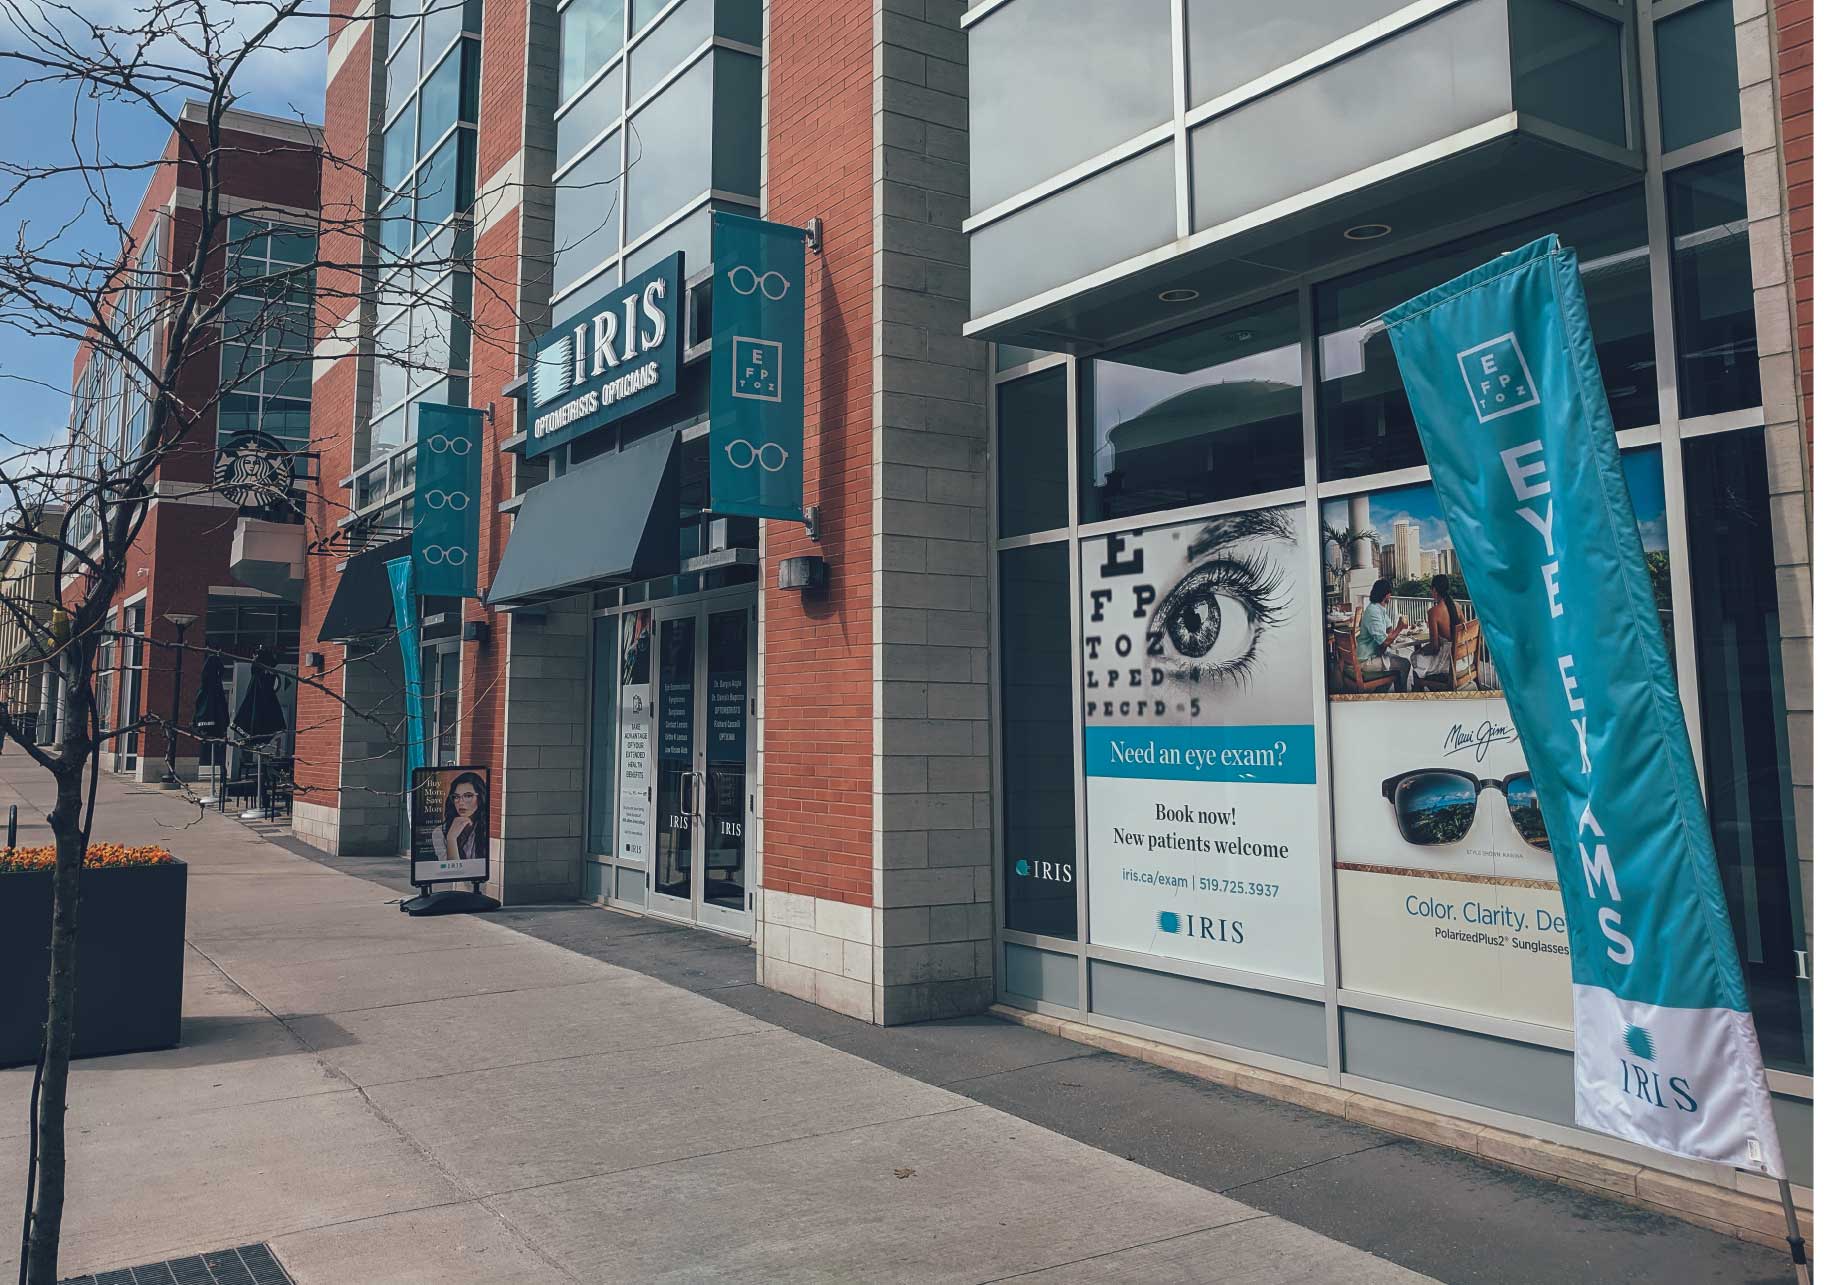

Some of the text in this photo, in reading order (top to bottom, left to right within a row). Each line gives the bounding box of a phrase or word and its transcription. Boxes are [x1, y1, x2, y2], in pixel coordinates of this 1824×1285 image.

[573, 277, 666, 386] IRIS
[752, 349, 763, 365] E
[1480, 353, 1498, 375] E
[534, 361, 660, 438] OPTOMETRISTS OPTICIANS
[1499, 440, 1564, 619] EYE
[1100, 530, 1144, 578] E
[1443, 724, 1475, 749] Maui
[625, 751, 646, 759] EXTENDED
[1110, 740, 1287, 770] Need an eye exam?
[626, 771, 644, 779] BENEFITS
[669, 815, 689, 830] IRIS
[1155, 803, 1236, 826] Book now!
[721, 821, 742, 837] IRIS
[1113, 827, 1289, 859] New patients welcome
[1033, 860, 1072, 883] IRIS
[1122, 868, 1280, 898] iris.ca/exam 519.725.3937
[1406, 895, 1570, 934] Color. Clarity. De
[1186, 914, 1244, 944] IRIS
[1512, 937, 1570, 956] Sunglasses
[1620, 1059, 1698, 1113] IRIS
